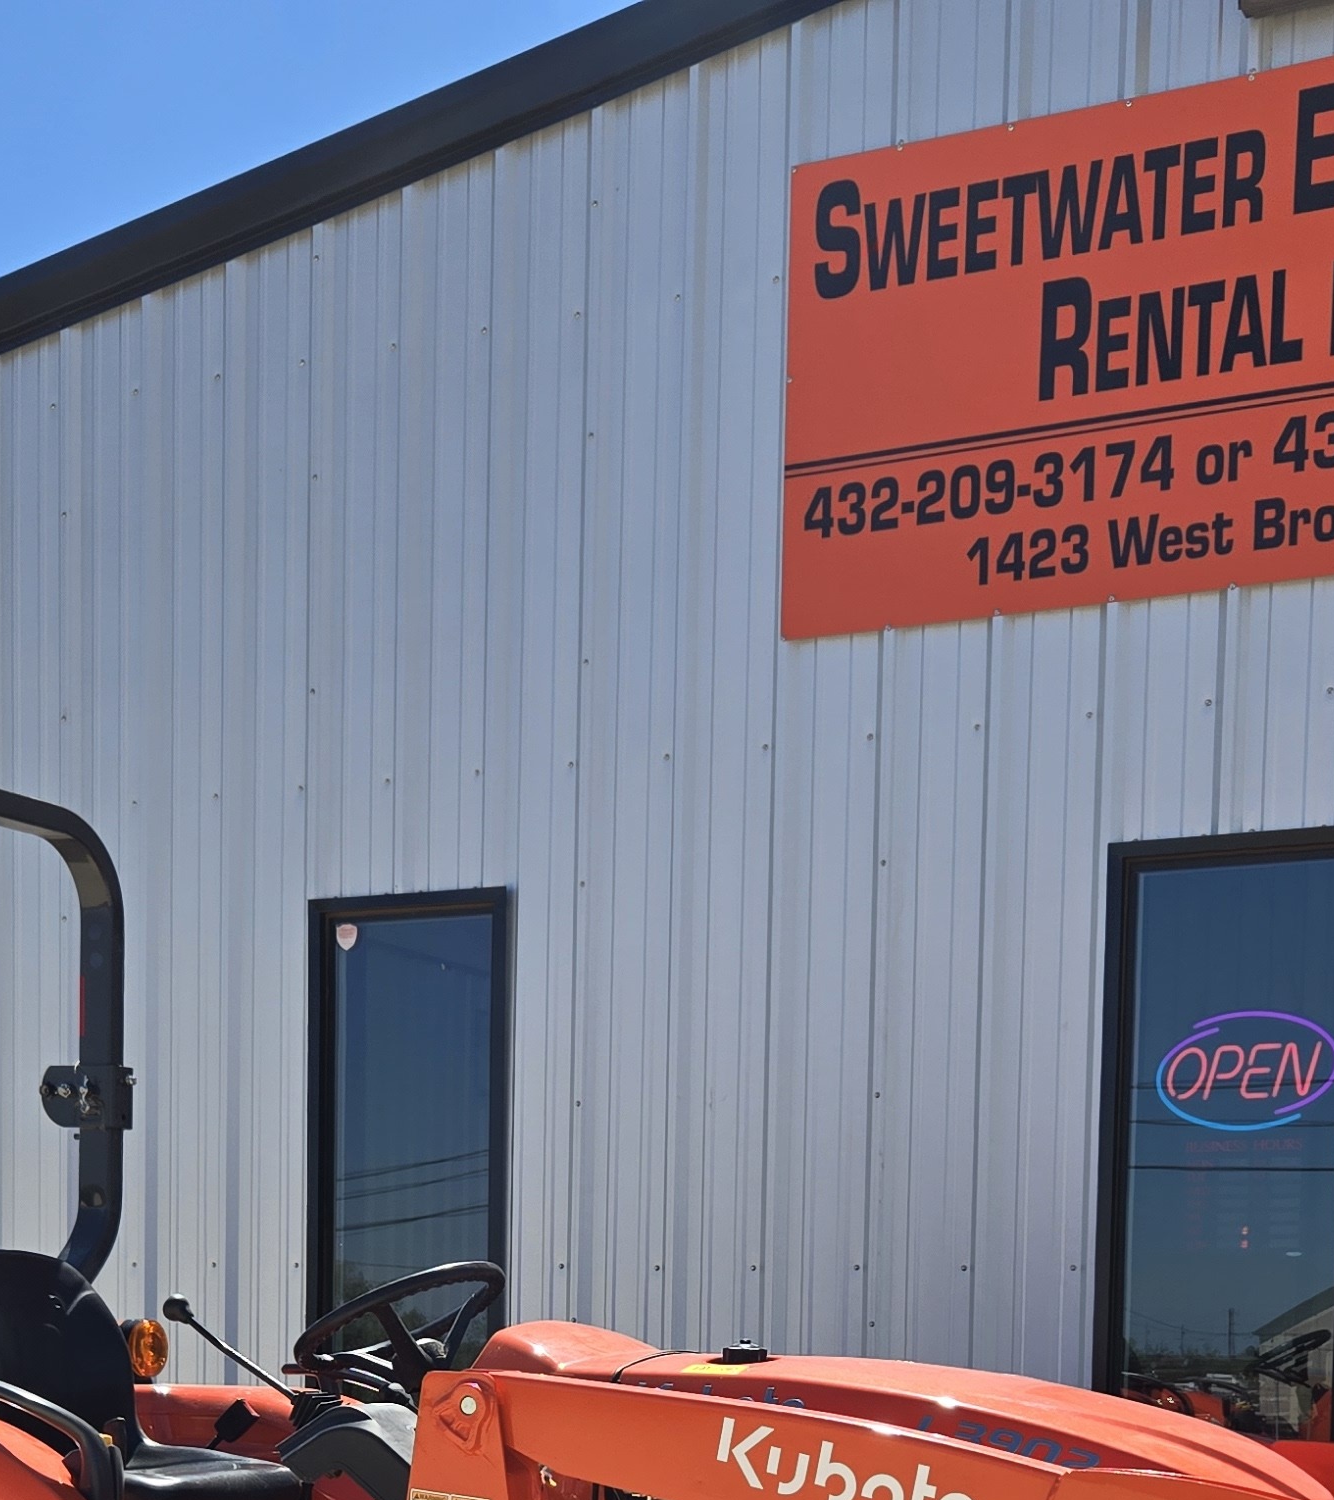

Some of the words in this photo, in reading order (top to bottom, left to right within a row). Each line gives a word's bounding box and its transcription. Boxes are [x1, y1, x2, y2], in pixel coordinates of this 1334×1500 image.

[814, 129, 1266, 300] SWEETWATER
[1038, 268, 1304, 402] RENTAL
[803, 434, 1175, 540] 432-209-3174
[1194, 438, 1254, 486] or
[966, 523, 1089, 586] 1423
[1107, 510, 1234, 569] West
[1166, 1040, 1323, 1101] OPEN
